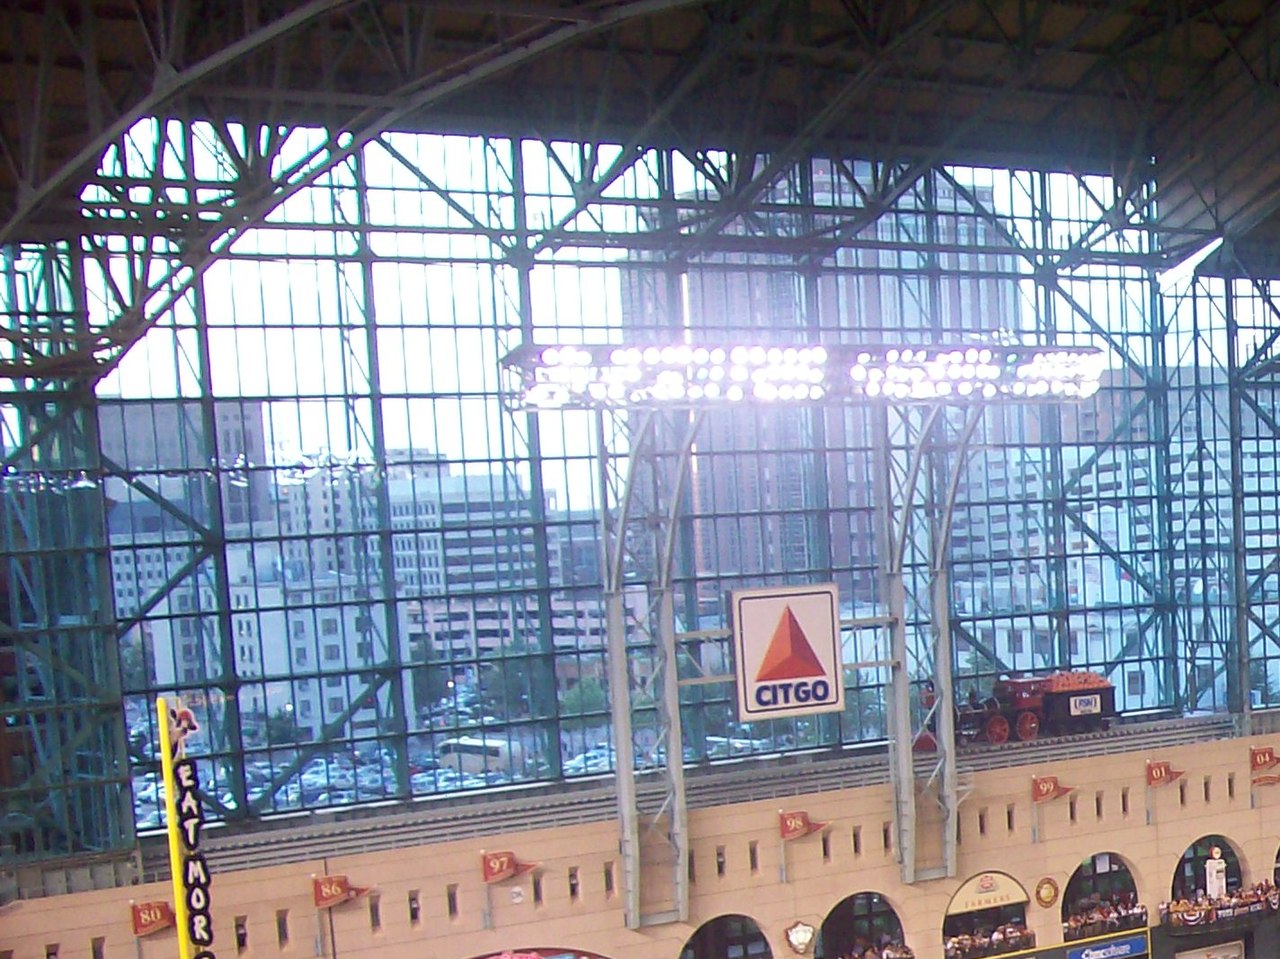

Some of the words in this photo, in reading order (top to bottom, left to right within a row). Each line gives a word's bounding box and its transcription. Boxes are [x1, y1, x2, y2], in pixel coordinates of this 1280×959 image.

[755, 680, 829, 706] CITGO
[1256, 753, 1270, 764] 04
[1152, 768, 1166, 778] 01
[1039, 781, 1054, 793] 99
[176, 763, 201, 846] EAT
[786, 818, 803, 831] 98
[490, 857, 508, 873] 97
[320, 882, 342, 898] 86
[187, 860, 210, 941] MOR
[140, 907, 162, 924] 80
